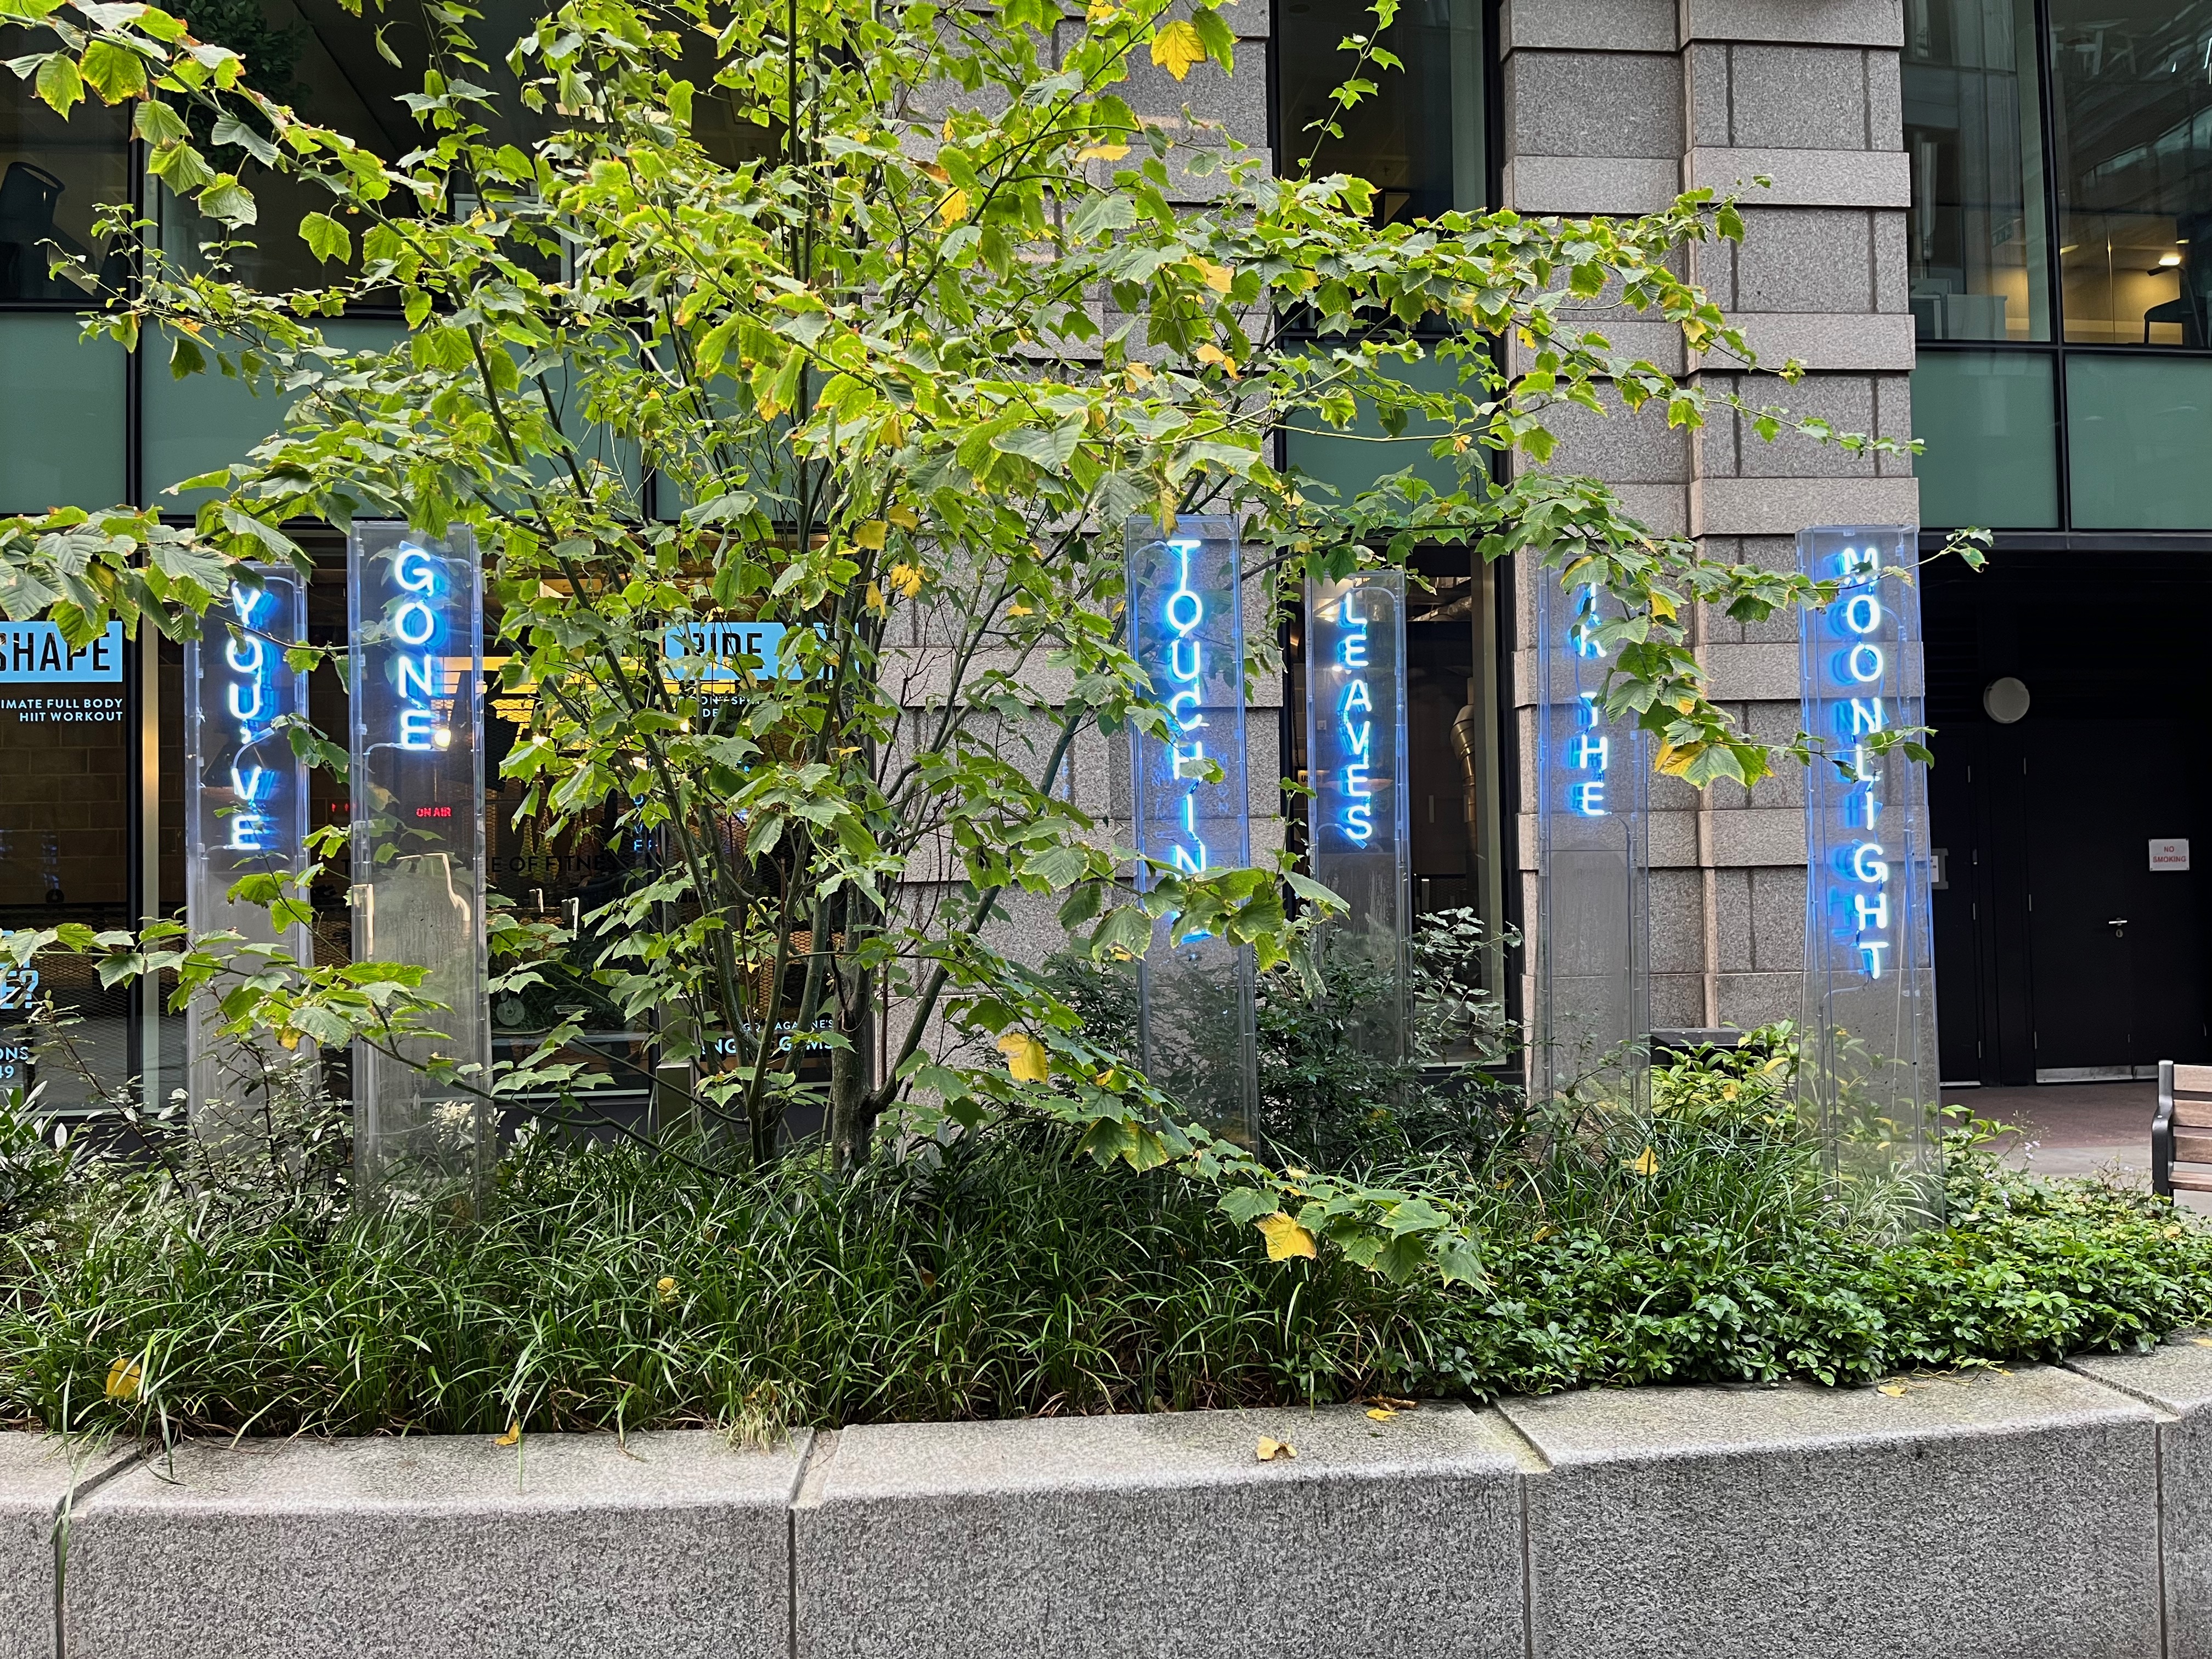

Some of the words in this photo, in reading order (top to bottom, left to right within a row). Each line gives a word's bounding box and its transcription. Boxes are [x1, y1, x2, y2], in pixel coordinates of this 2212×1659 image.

[394, 548, 435, 751] GONE
[0, 699, 42, 709] IMATE
[47, 699, 80, 709] FULL
[84, 698, 123, 708] BODY
[20, 712, 46, 722] HIIT
[50, 711, 123, 722] WORKOUT
[1345, 591, 1373, 840] LEAVES
[1166, 539, 1207, 936] TOUCHIN
[1579, 692, 1609, 816] THE
[1843, 547, 1889, 980] MOONLIGHT
[416, 806, 431, 817] ON
[433, 806, 452, 817] AIR
[509, 855, 539, 872] OF
[546, 855, 624, 872] FITNE
[2152, 855, 2187, 864] SMOKING
[772, 1019, 833, 1030] AGANE'S
